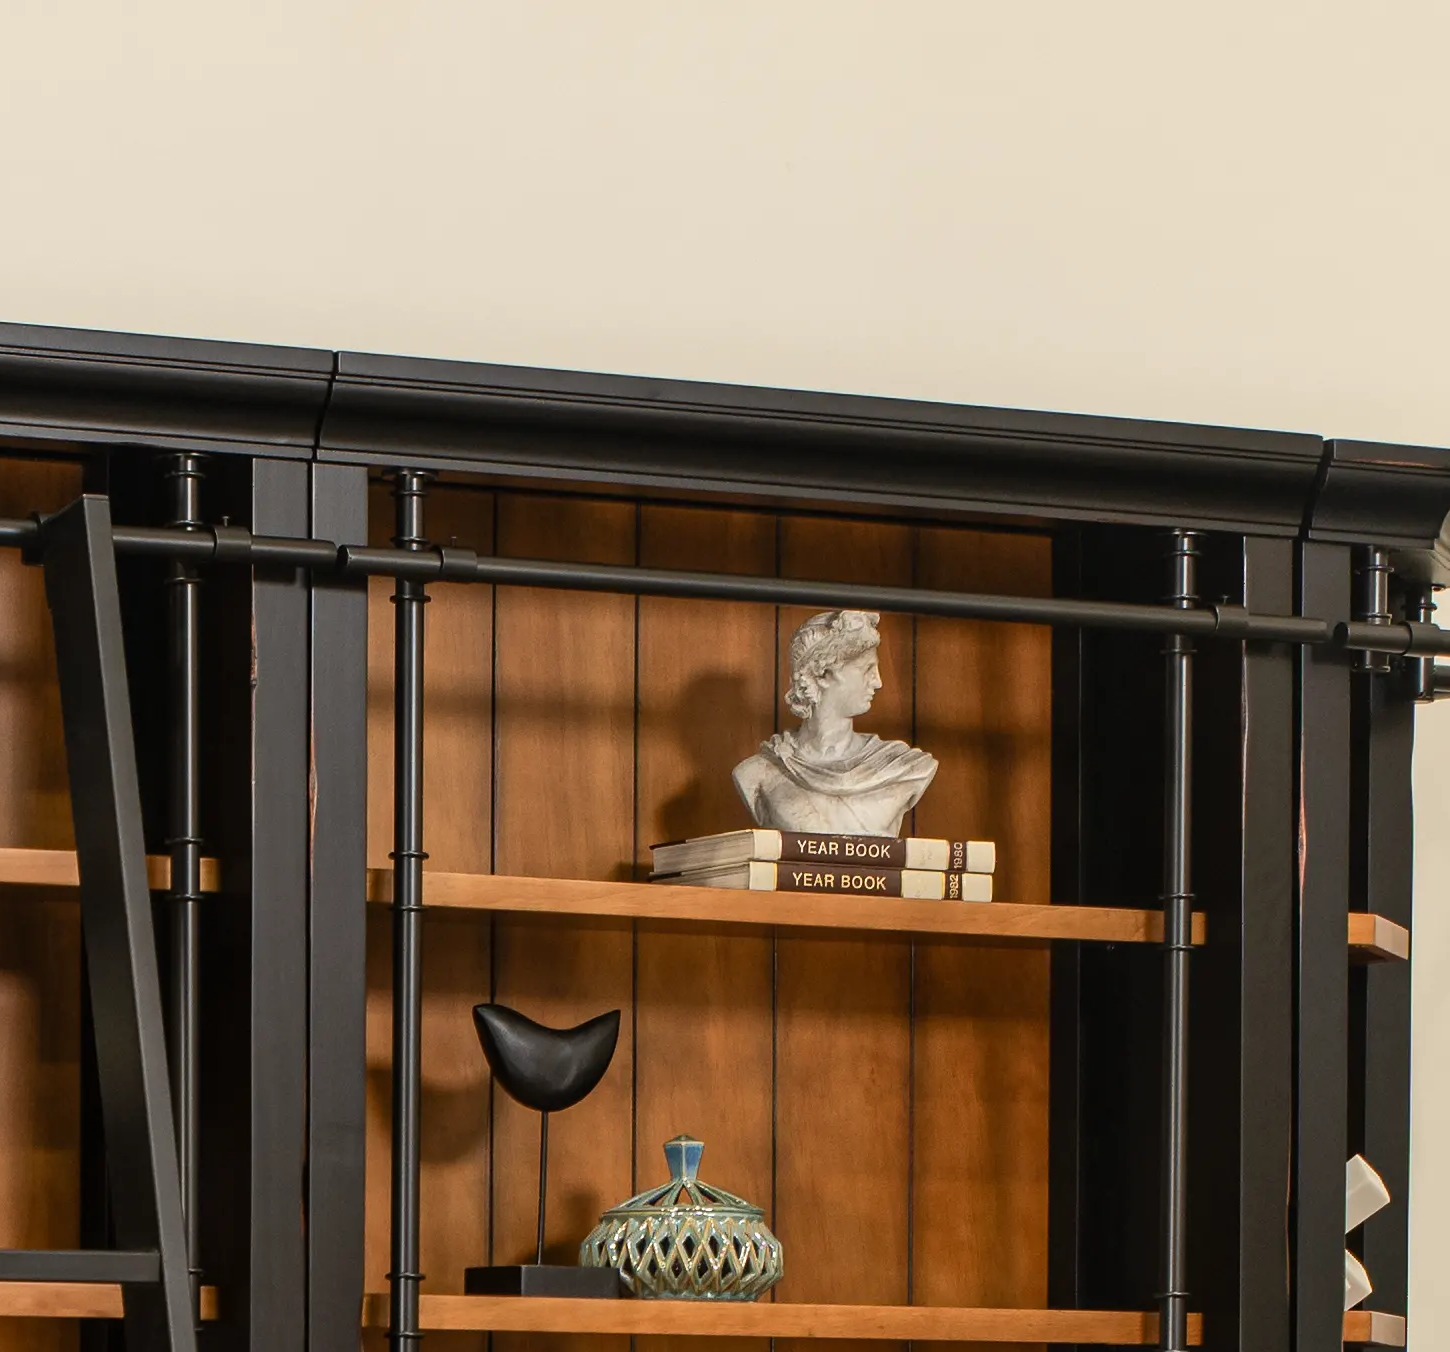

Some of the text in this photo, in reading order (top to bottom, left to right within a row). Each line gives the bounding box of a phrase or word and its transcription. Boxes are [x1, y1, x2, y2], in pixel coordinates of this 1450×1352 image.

[797, 839, 891, 859] YEAR BOOK
[953, 842, 963, 869] 1980
[792, 872, 886, 890] YEAR BOOK
[949, 873, 959, 899] 1982
